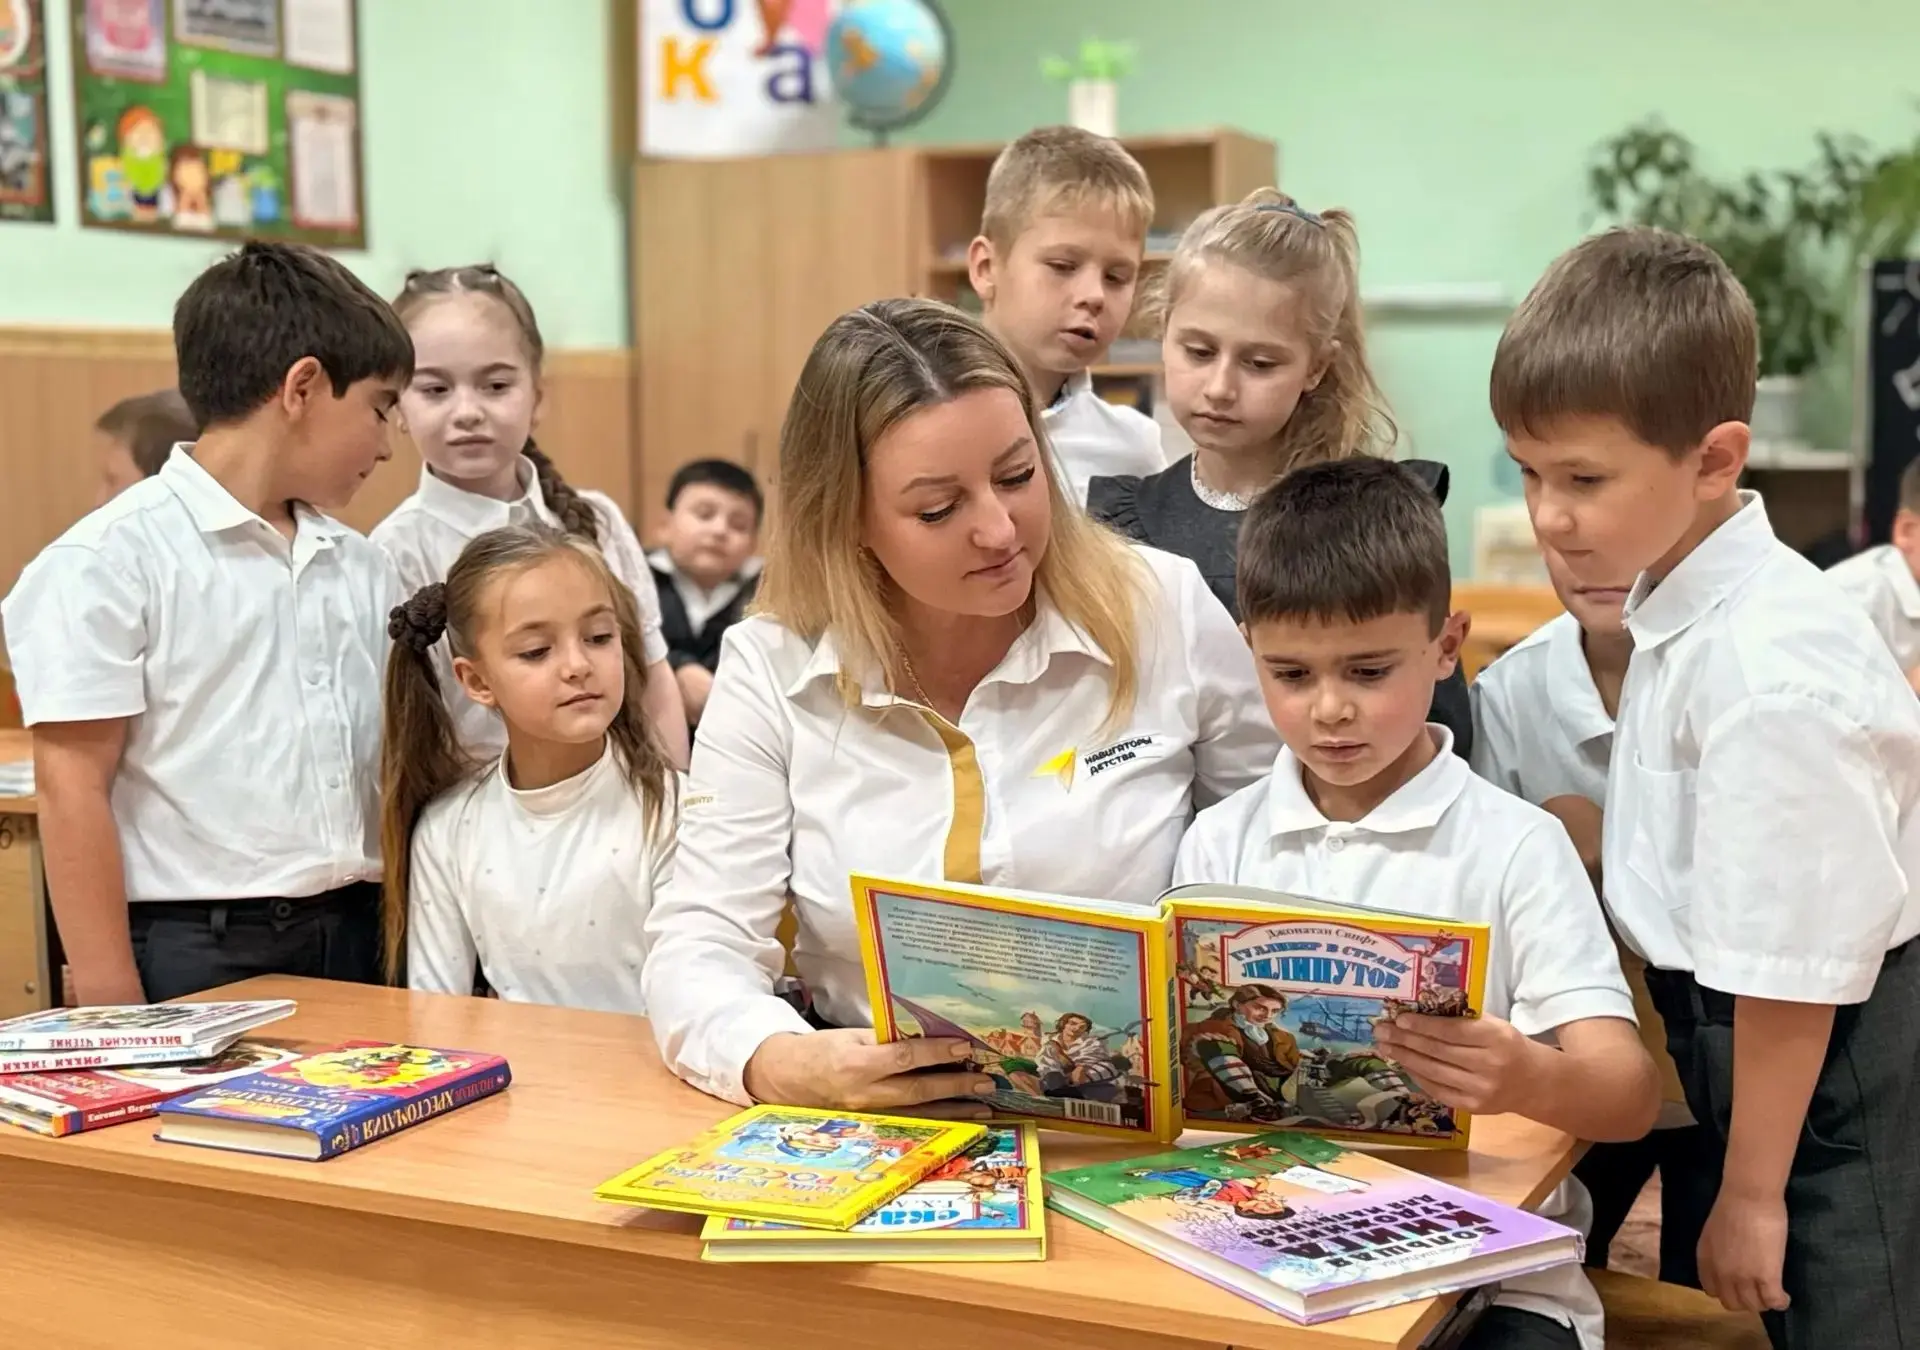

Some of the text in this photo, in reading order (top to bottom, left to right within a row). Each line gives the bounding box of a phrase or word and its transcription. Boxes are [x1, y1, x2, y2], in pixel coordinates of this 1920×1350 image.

[1265, 927, 1378, 946] Джонатан Свифт
[1241, 956, 1401, 989] ЛИЛИПУТОВ
[362, 1087, 456, 1140] ХРЕСТОМАТИЯ
[1240, 1194, 1437, 1240] ДЛЯ МАЛЬЧИКОВ
[1251, 1201, 1463, 1248] ХУДОЖНИКА
[1278, 1210, 1493, 1260] КНИГА
[1324, 1227, 1502, 1268] БОЛЬШАЯ
